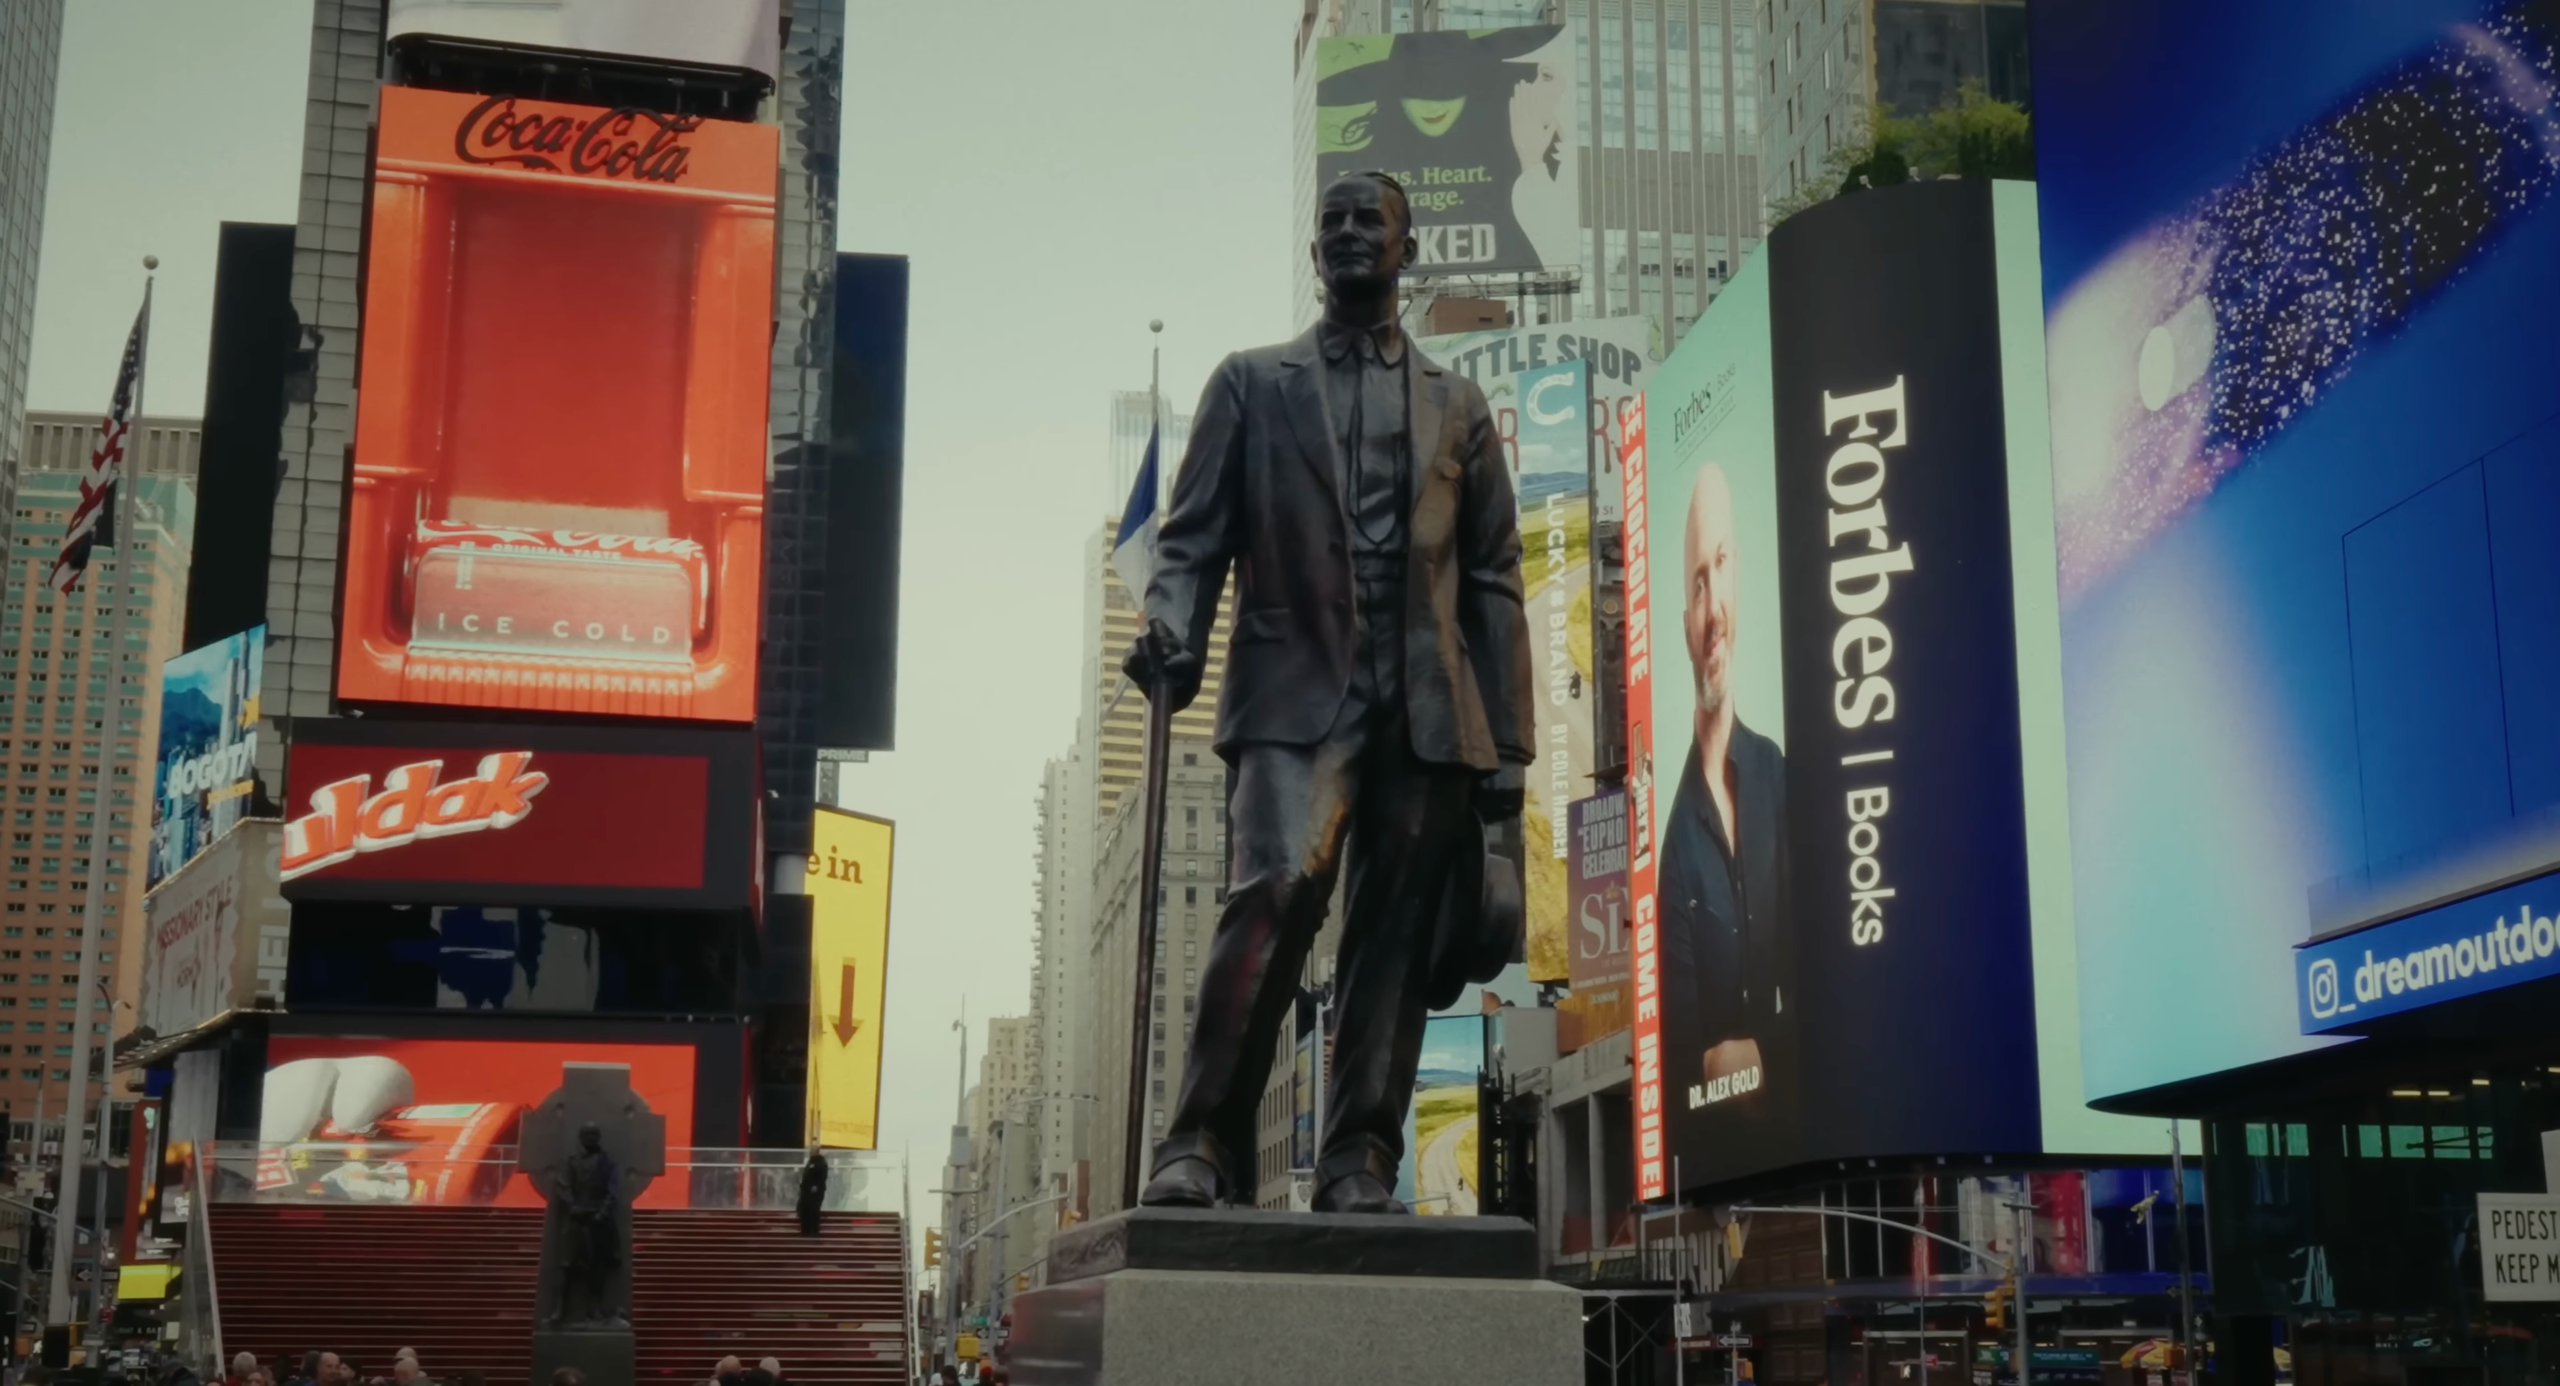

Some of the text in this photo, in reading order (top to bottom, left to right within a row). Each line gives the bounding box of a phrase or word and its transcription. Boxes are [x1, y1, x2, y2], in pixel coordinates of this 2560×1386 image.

[455, 94, 704, 183] Coca-Cola
[1422, 164, 1493, 186] Heart.
[1409, 188, 1464, 212] rage.
[1413, 223, 1496, 265] KED
[1452, 333, 1642, 387] ITTLE SHOP
[1673, 381, 1712, 444] Forbes
[1546, 492, 1567, 586] LUCKY
[1625, 445, 1649, 687] CHOCOLATE
[437, 612, 671, 644] ICE COLD
[1549, 610, 1568, 707] BRAND
[1823, 374, 1915, 947] Forbes Books
[1551, 723, 1568, 744] BY
[1551, 750, 1569, 791] COLE
[1582, 792, 1625, 827] BROADW
[826, 844, 863, 884] in
[1582, 842, 1627, 880] CELEBRAT
[1636, 893, 1658, 1024] COME
[1689, 1065, 1760, 1110] DR. ALEX GOLD
[2491, 1209, 2560, 1240] PEDEST
[2495, 1253, 2560, 1284] KEEP M
